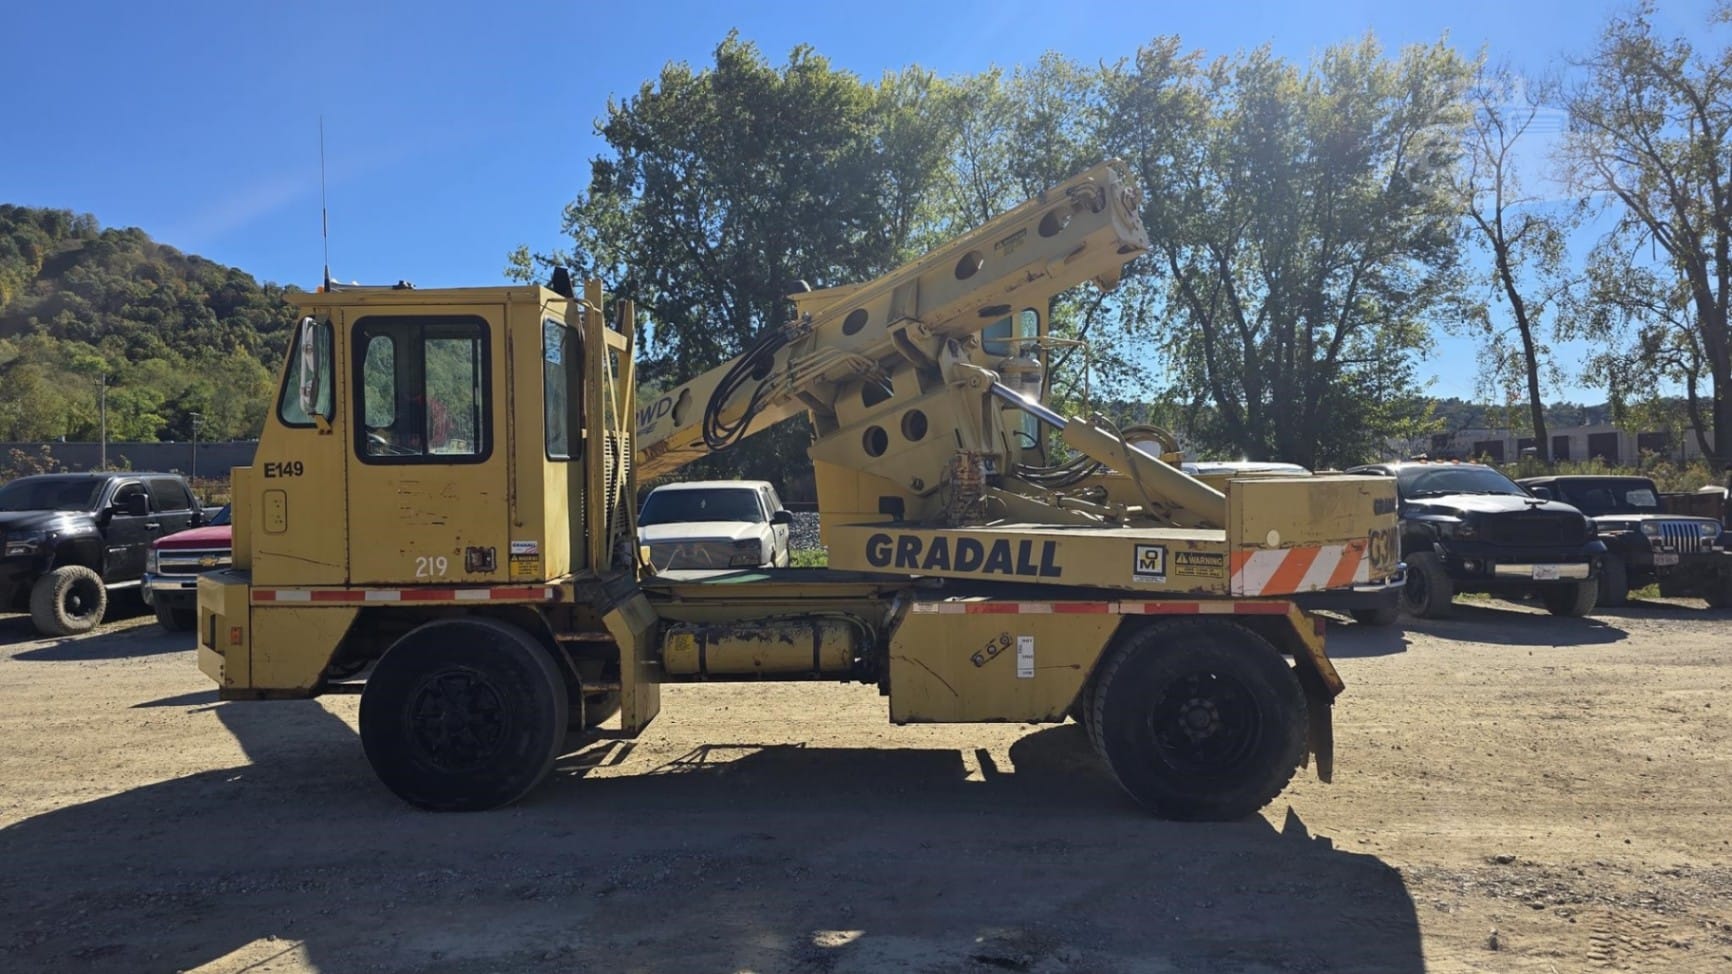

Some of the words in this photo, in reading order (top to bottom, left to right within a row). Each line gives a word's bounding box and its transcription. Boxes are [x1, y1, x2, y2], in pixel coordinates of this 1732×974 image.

[636, 396, 673, 427] WD
[263, 461, 304, 478] E149
[415, 556, 448, 578] 219
[865, 533, 1063, 577] GRADALL
